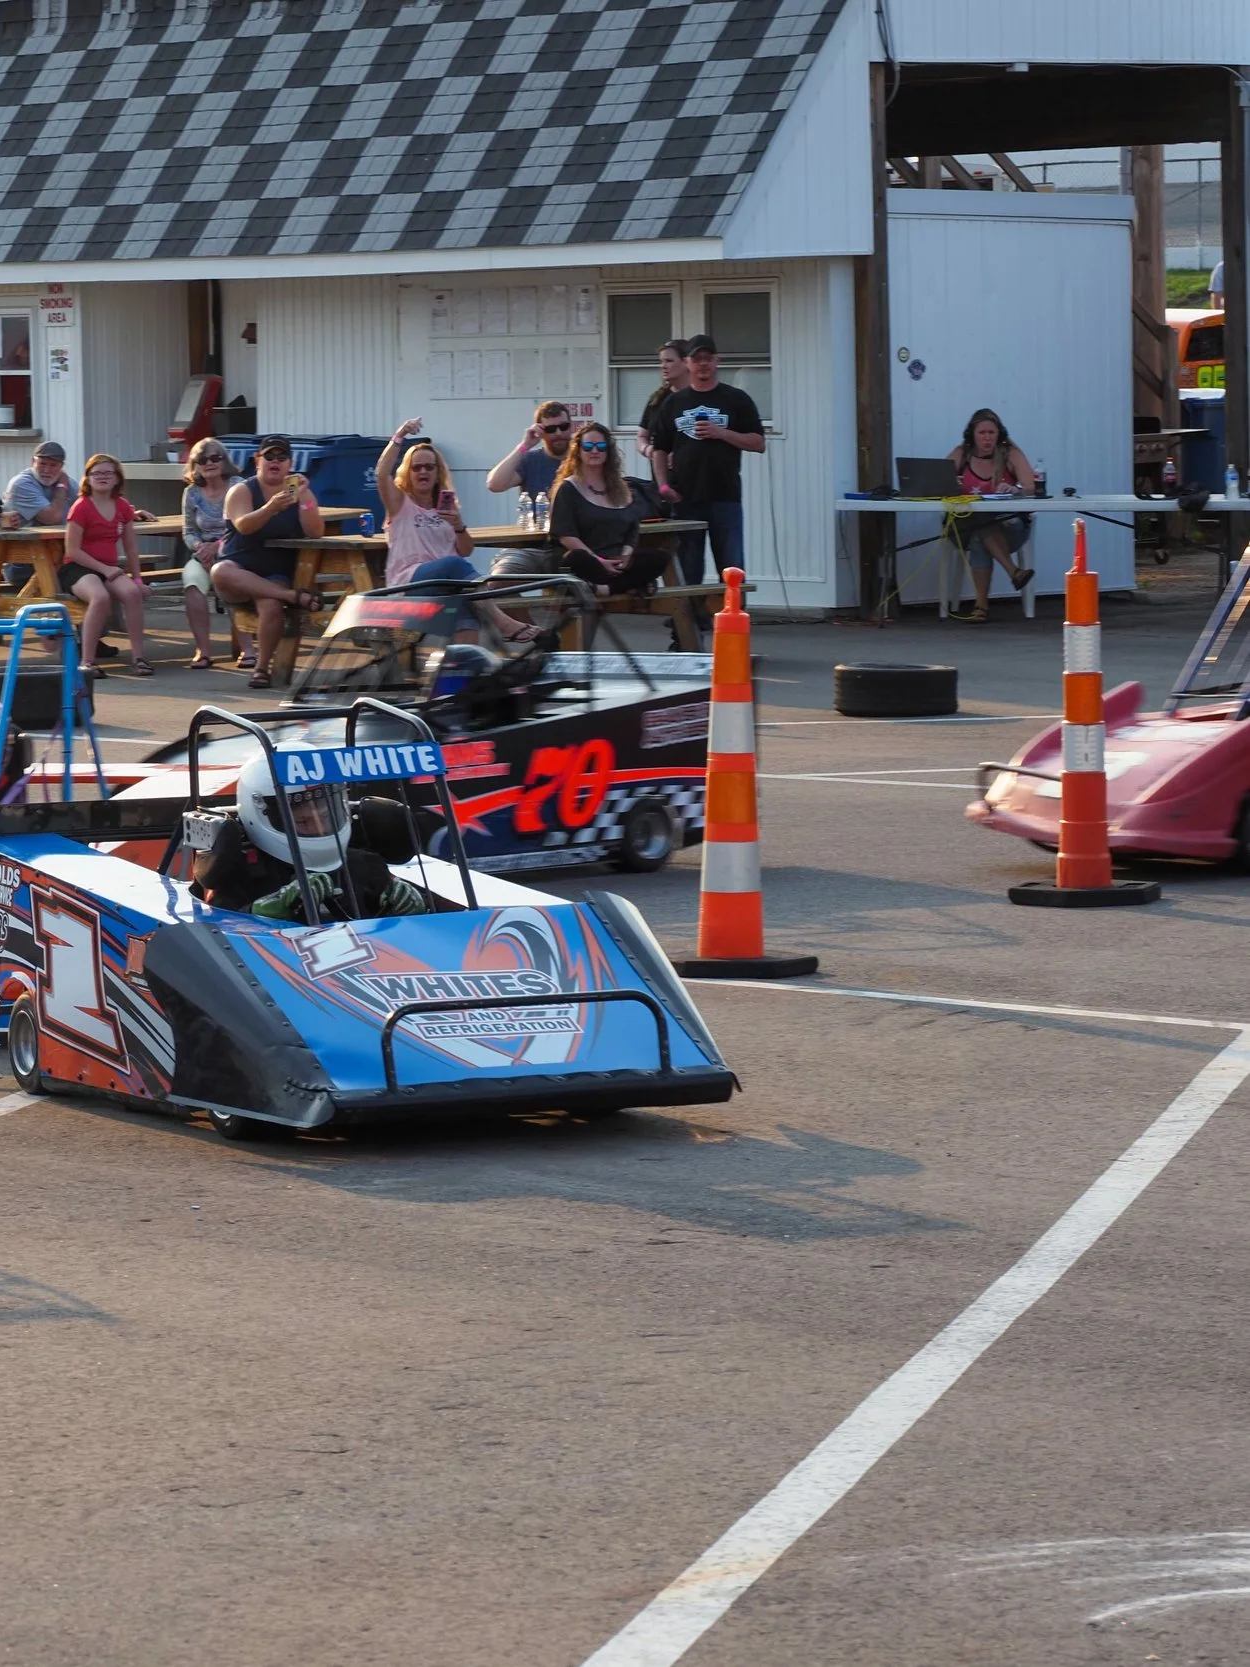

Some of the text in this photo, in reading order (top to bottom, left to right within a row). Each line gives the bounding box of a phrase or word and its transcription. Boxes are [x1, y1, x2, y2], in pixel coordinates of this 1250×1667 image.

[40, 297, 74, 310] SMOKING
[47, 311, 67, 323] AREA
[287, 752, 325, 784] AJ
[334, 745, 439, 777] WHITE
[512, 738, 617, 833] 70
[34, 889, 128, 1068] 1
[366, 972, 554, 1000] WHITES
[467, 1010, 505, 1022] AND
[424, 1020, 572, 1036] REFRIGERATION
